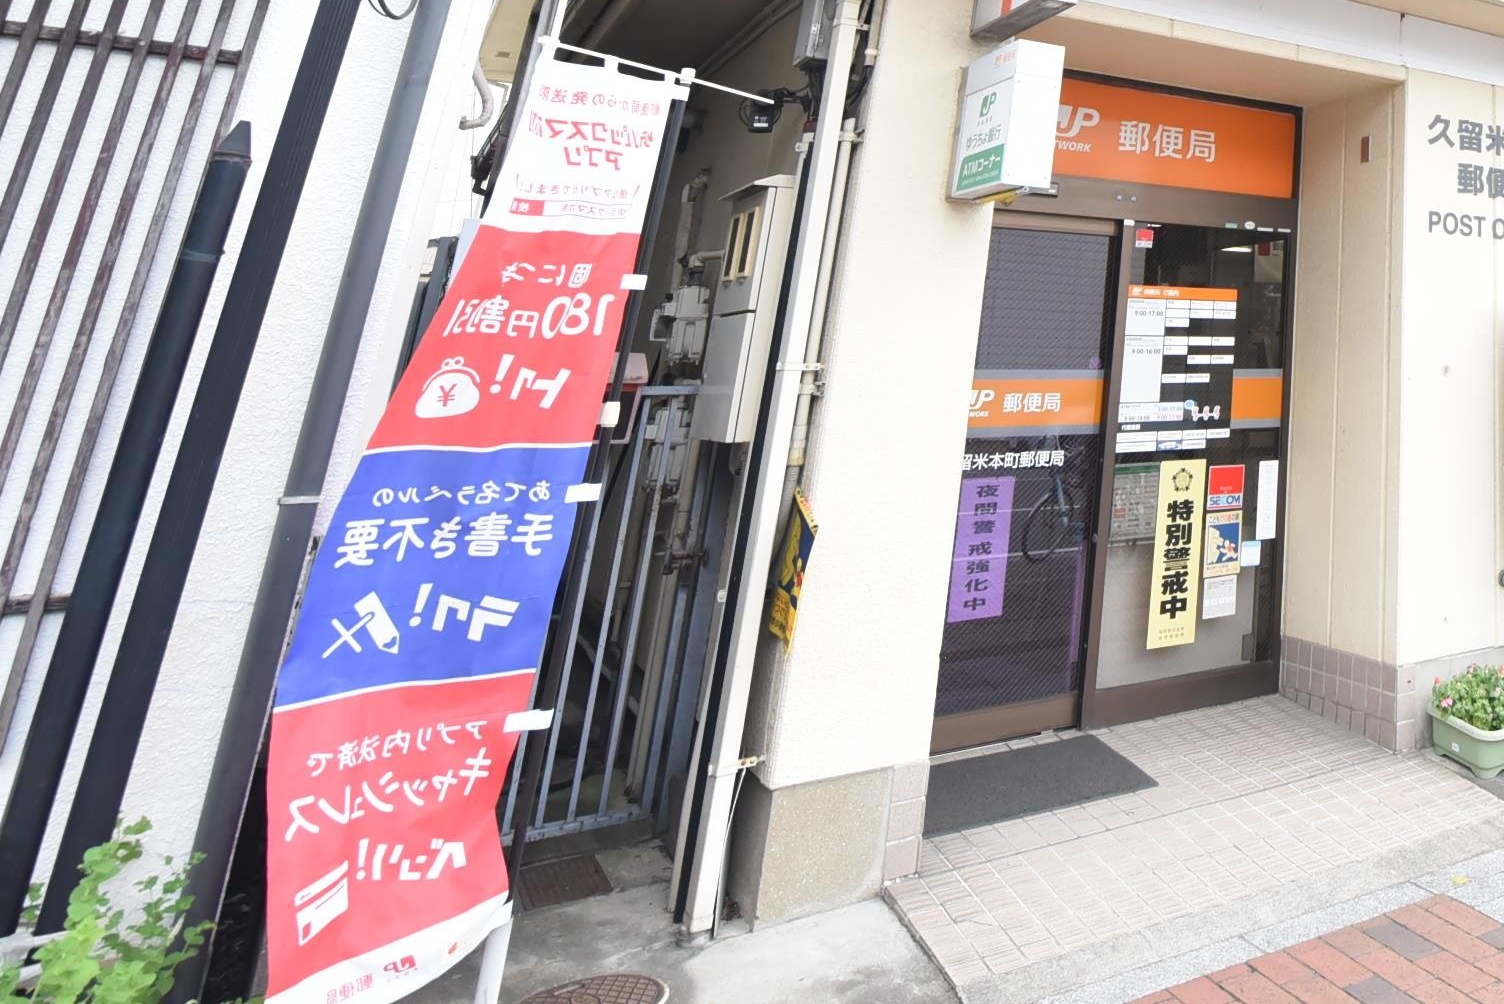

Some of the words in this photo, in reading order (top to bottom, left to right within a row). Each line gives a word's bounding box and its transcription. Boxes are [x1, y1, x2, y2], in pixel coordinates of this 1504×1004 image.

[966, 124, 1002, 151] ゆうちょ銀行
[1054, 139, 1092, 153] TWORK
[1118, 120, 1216, 163] 郵便局
[963, 154, 1001, 177] ATMコーナー
[1428, 211, 1486, 237] POST
[1002, 392, 1061, 413] 郵便局
[960, 450, 1065, 472] 留米本町郵便局
[1209, 495, 1241, 506] SECOM
[963, 484, 1001, 612] 夜間警戒強化中
[1159, 499, 1194, 620] 特別警戒中
